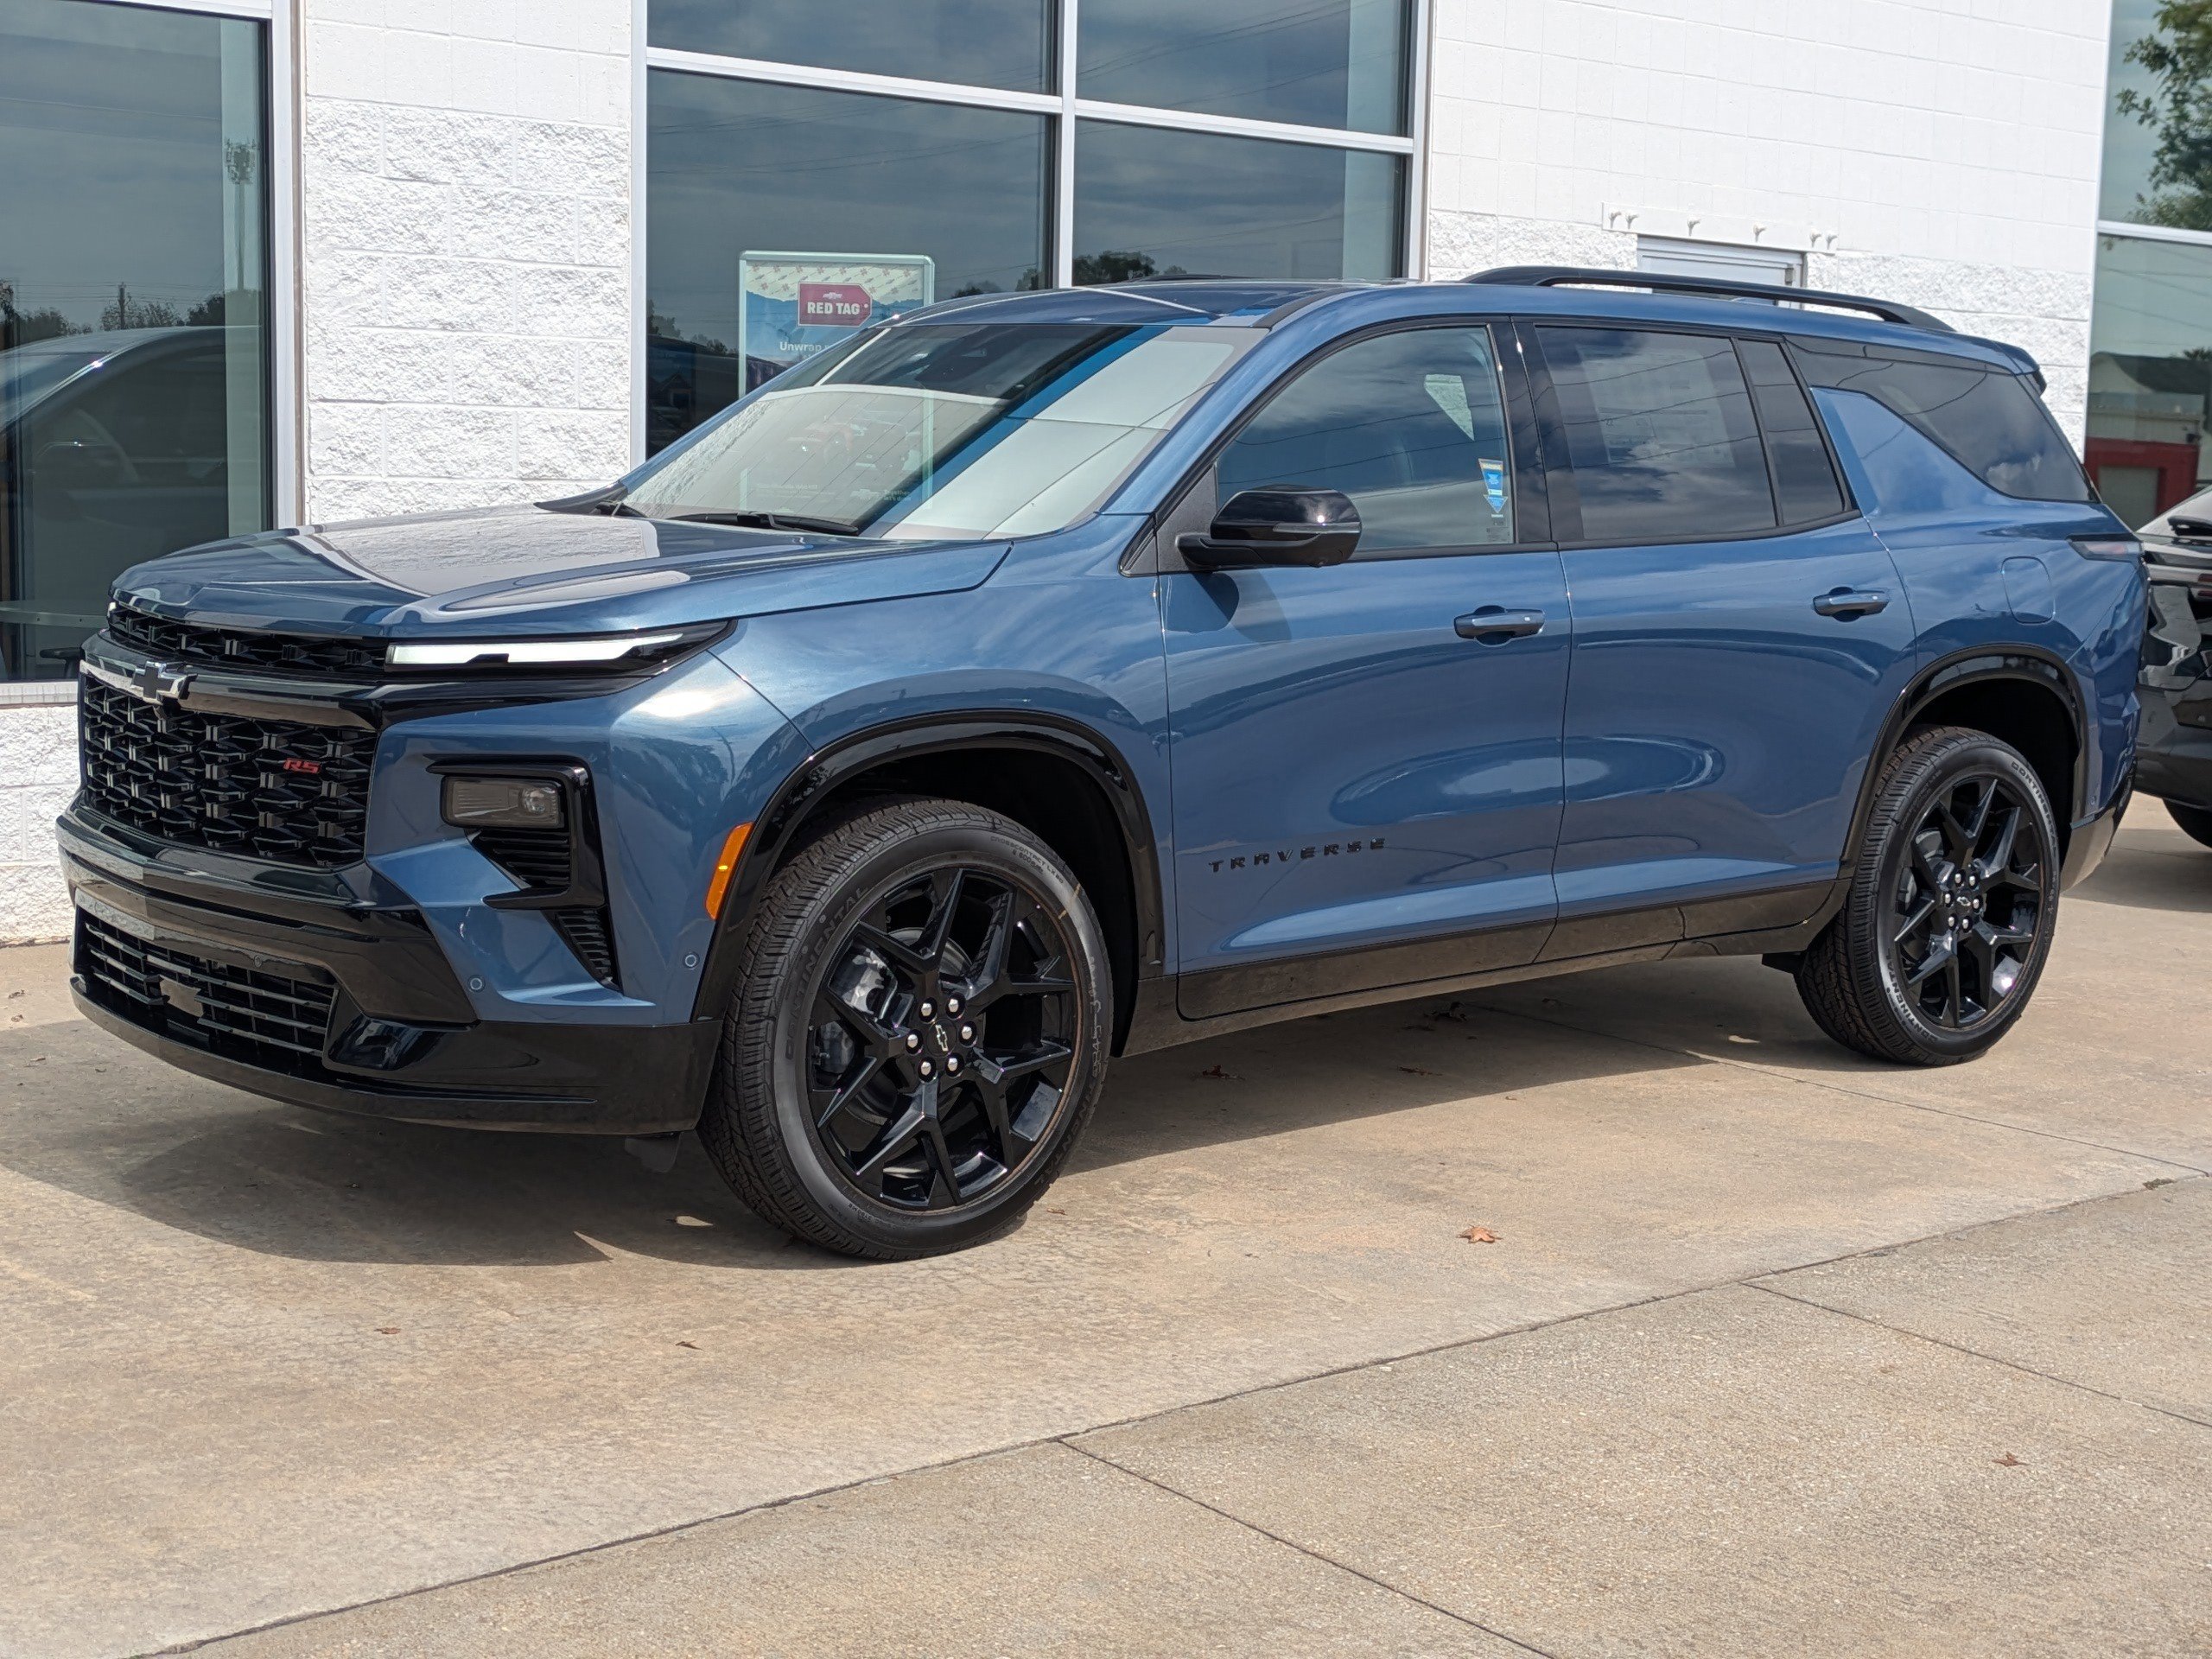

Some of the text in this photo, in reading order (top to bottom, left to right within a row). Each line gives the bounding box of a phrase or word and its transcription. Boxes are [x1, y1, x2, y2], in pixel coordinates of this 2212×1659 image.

[807, 302, 861, 315] RED TAG
[779, 341, 822, 353] Unwrap
[283, 757, 321, 773] RS
[2011, 760, 2057, 858] CONTINENTAL
[1208, 837, 1385, 873] TRAVERSE
